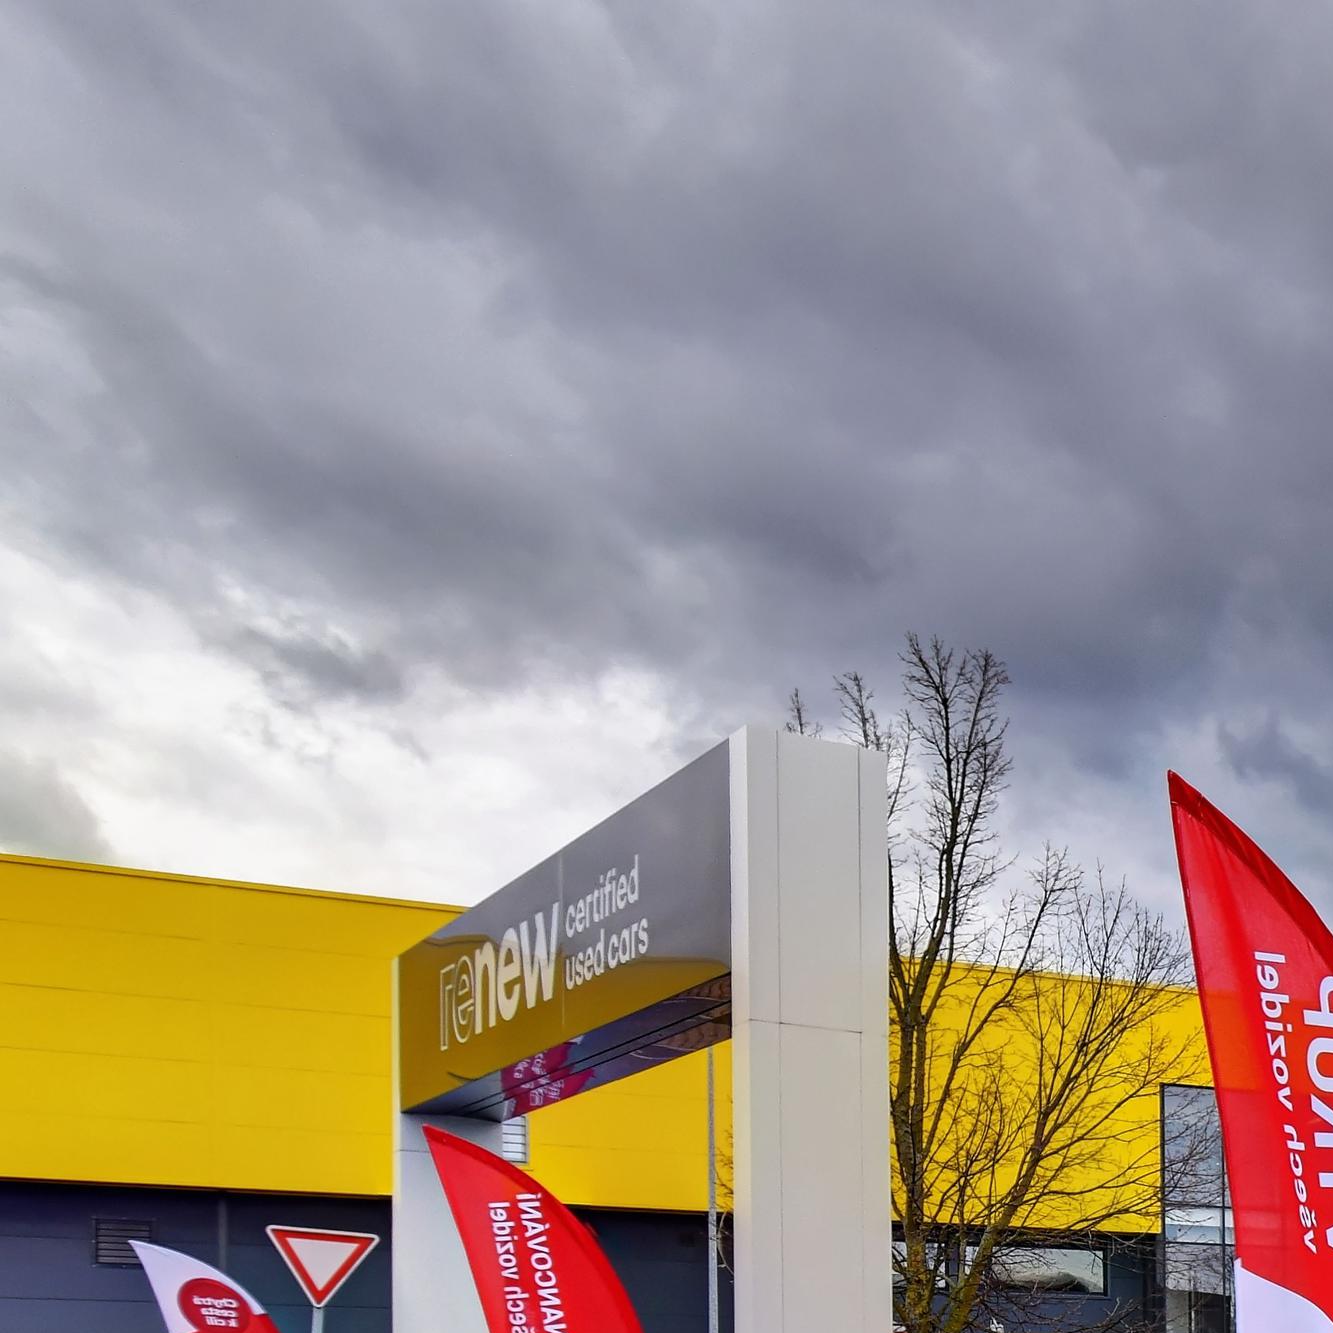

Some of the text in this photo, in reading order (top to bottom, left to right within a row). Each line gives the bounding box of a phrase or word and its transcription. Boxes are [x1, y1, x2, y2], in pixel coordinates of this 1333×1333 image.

[565, 854, 639, 938] certified
[440, 902, 560, 1051] renew
[565, 918, 649, 990] used cars
